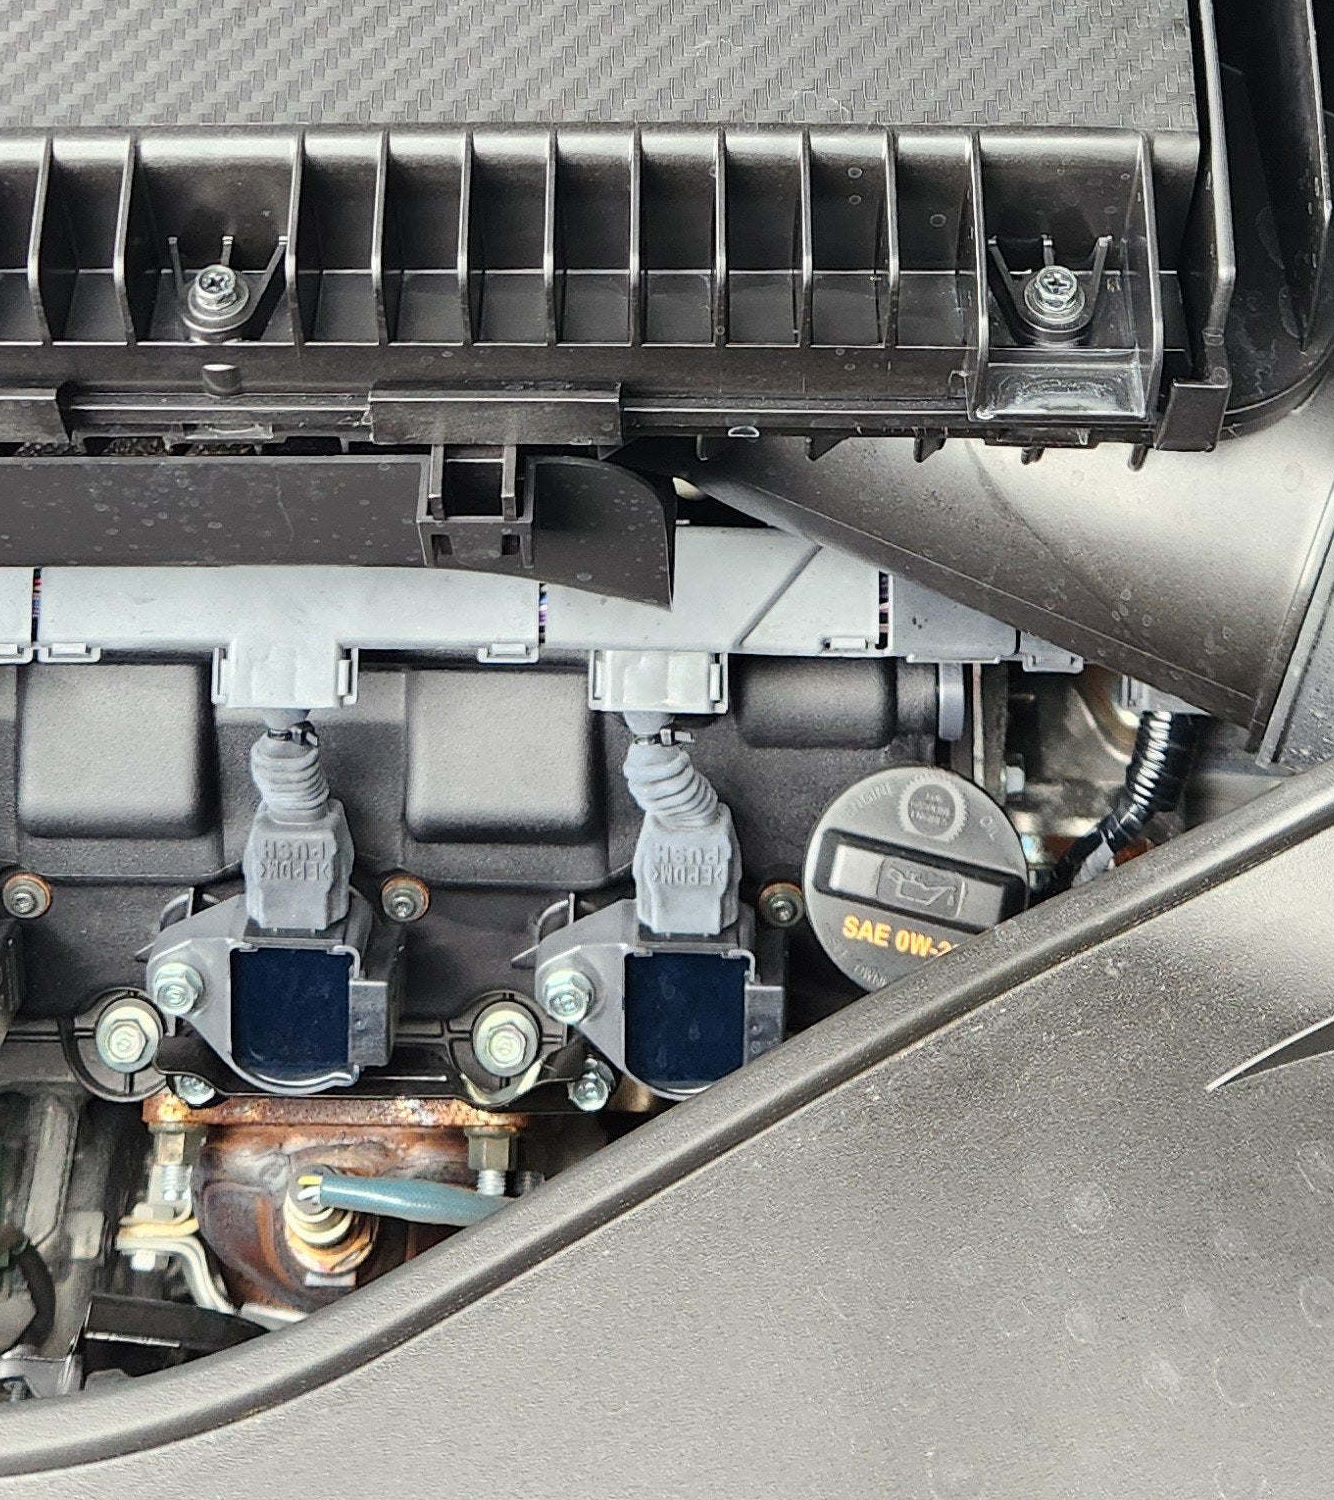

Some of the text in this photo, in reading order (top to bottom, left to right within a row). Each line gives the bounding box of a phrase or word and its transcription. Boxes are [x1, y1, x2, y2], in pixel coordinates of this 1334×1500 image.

[263, 839, 328, 860] PUSH
[656, 843, 721, 864] PUSH
[841, 914, 892, 948] SAE
[894, 928, 961, 958] 0W-2
